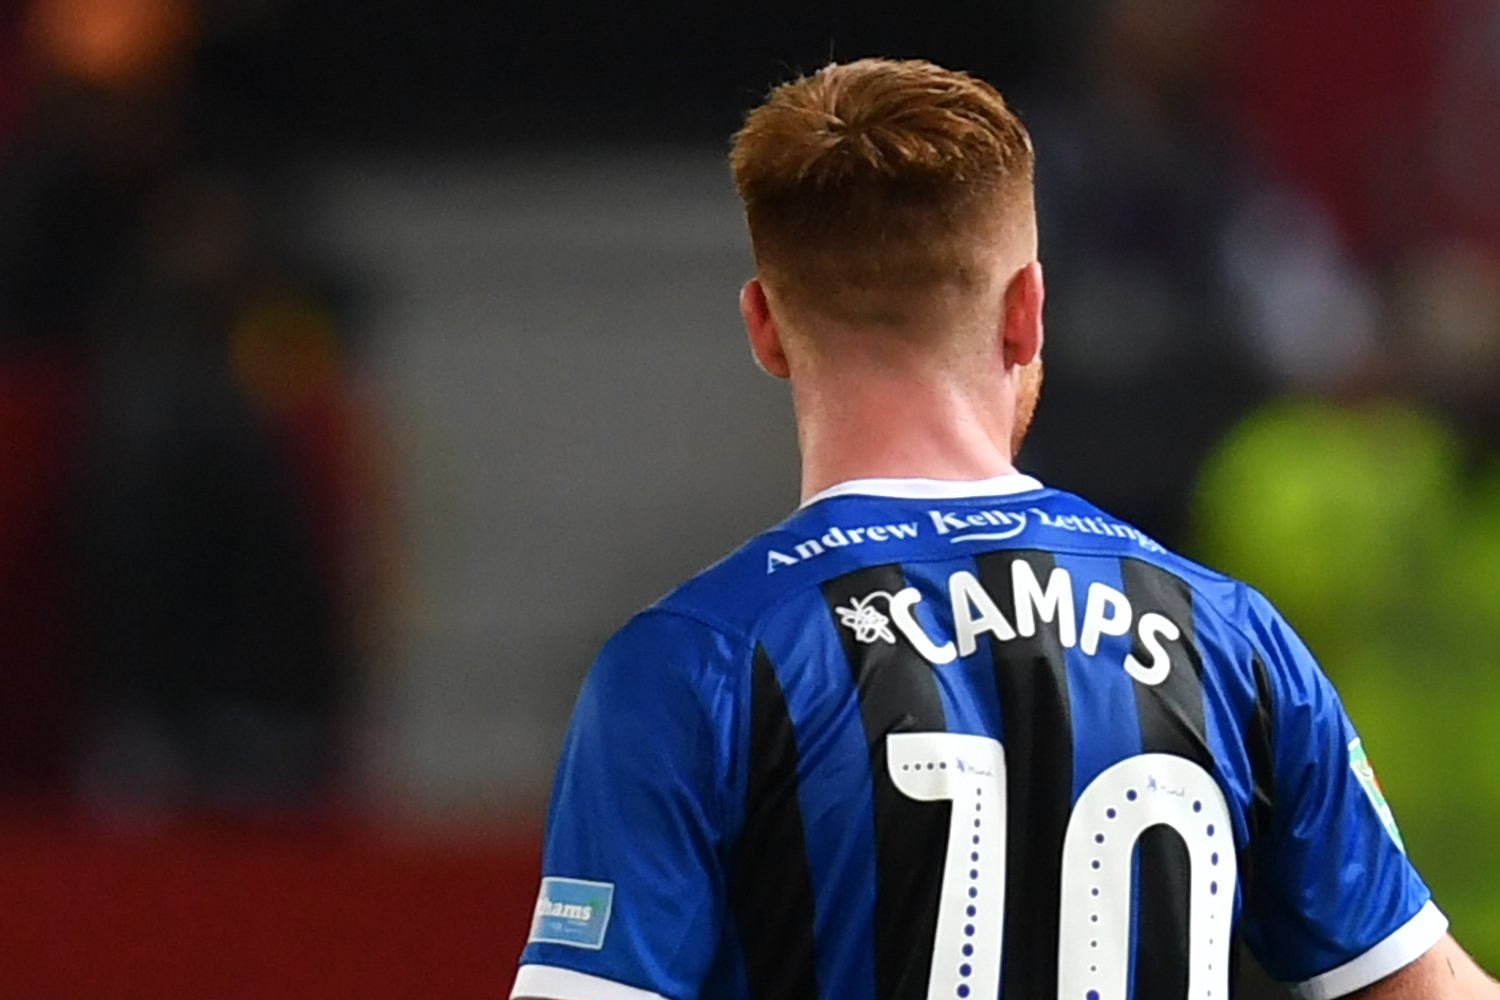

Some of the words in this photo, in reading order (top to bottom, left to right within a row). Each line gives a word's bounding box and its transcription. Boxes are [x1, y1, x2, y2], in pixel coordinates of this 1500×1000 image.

[766, 521, 919, 575] Andrew
[927, 509, 1027, 544] Kelly
[888, 558, 1181, 686] CAMPS
